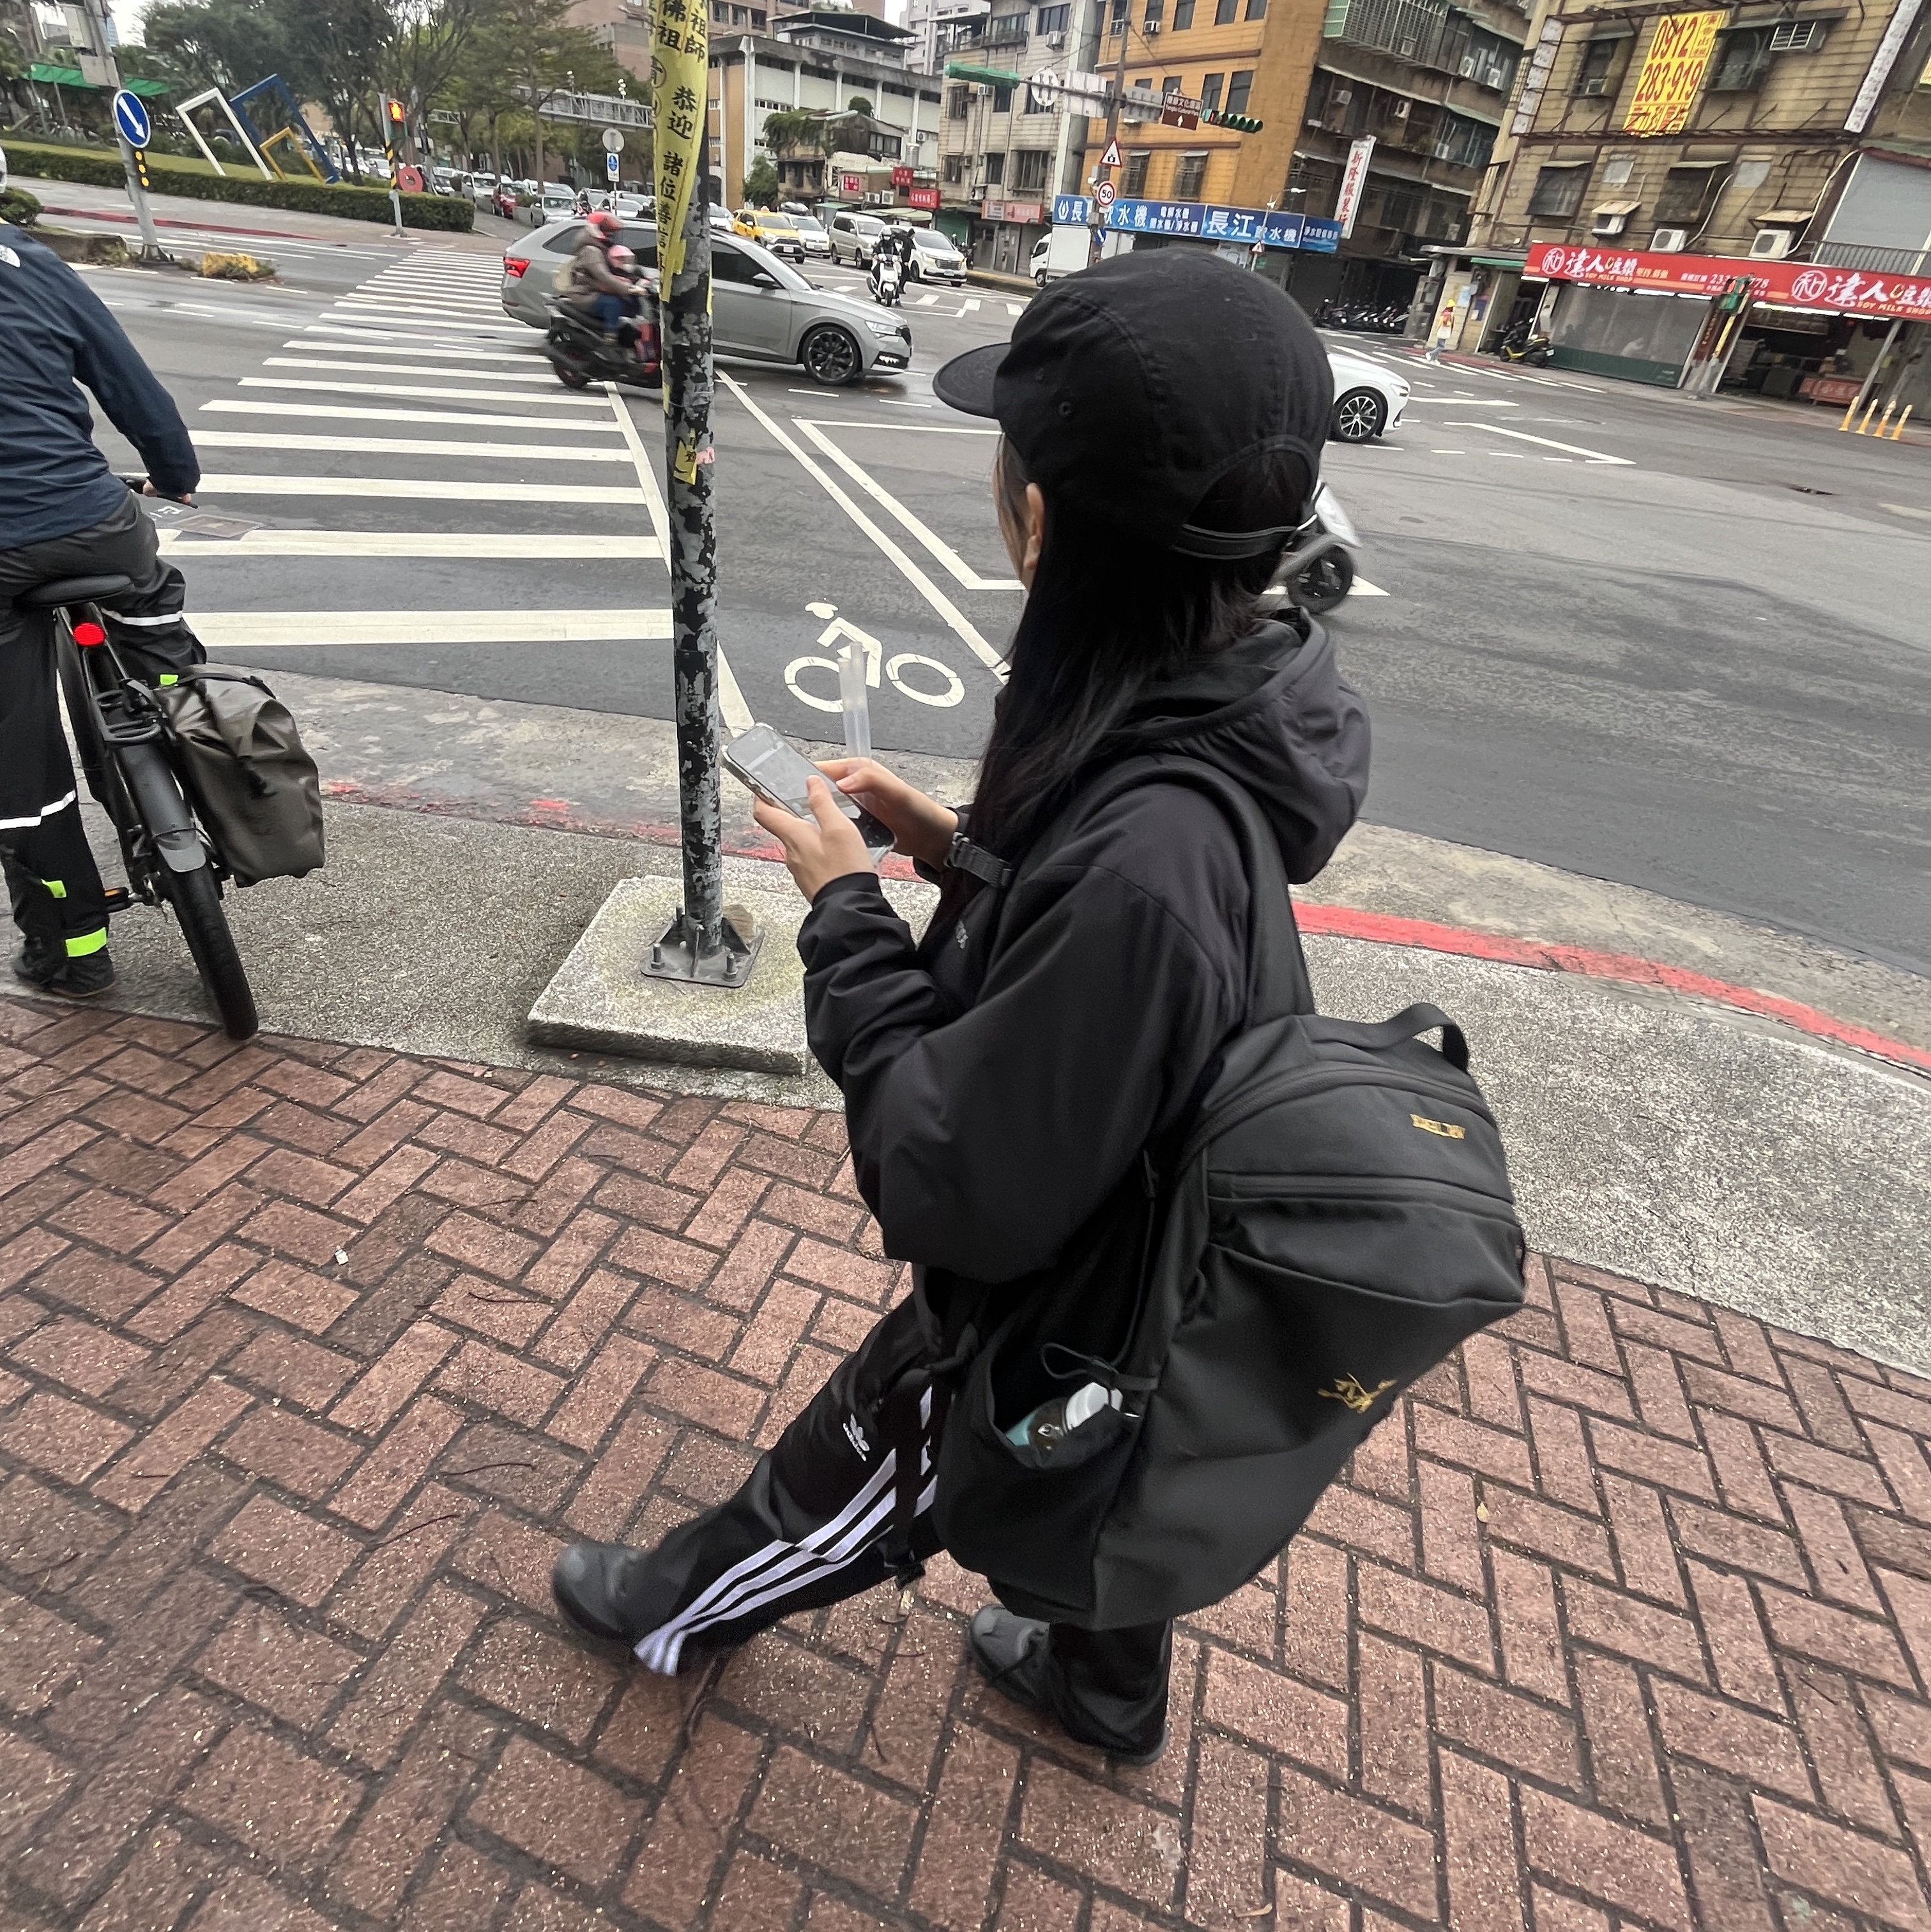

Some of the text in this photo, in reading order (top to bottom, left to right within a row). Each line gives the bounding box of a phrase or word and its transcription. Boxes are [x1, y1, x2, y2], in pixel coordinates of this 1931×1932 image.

[684, 0, 706, 63] 祖師
[1651, 17, 1698, 60] 0912
[1102, 189, 1112, 199] 50
[1856, 301, 1931, 316] SOY MILK SHOP
